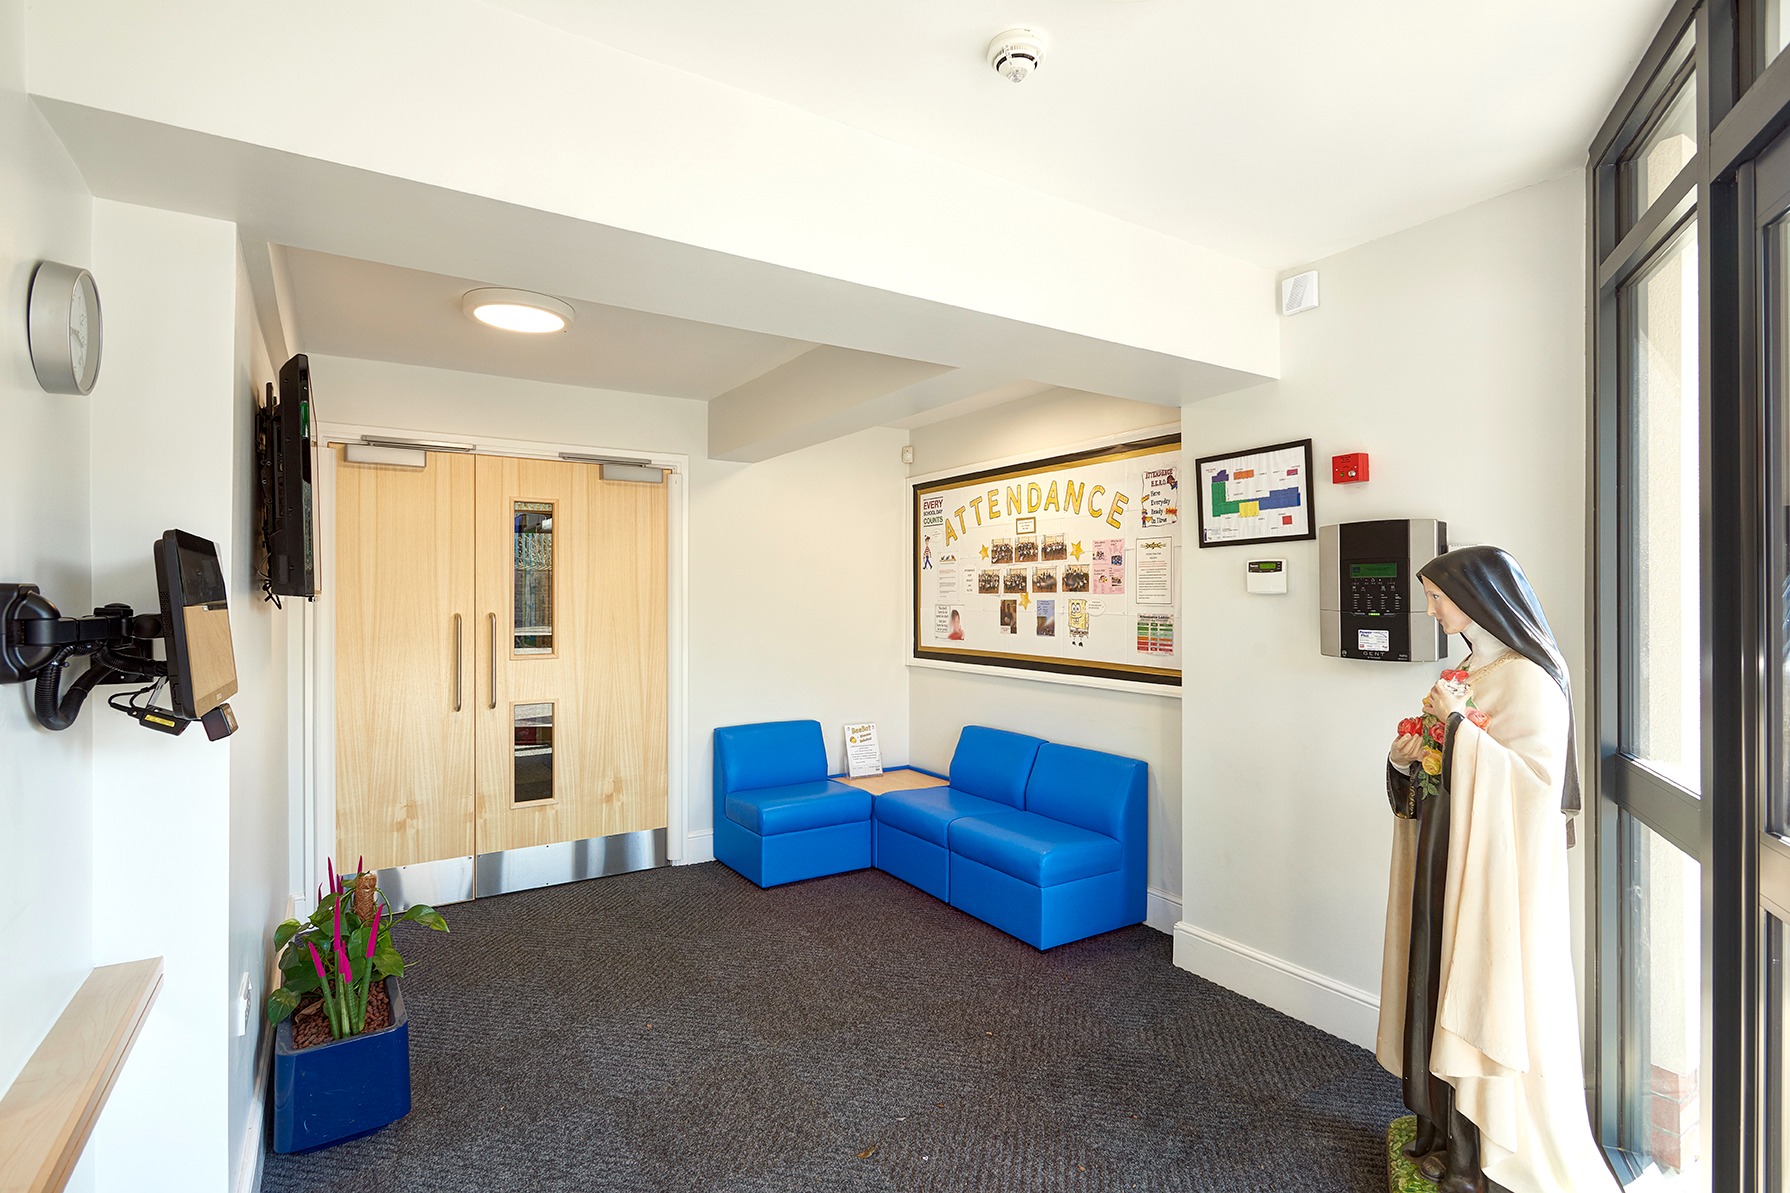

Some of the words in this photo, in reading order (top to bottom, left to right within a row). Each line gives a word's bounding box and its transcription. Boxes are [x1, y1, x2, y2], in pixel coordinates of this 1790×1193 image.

[923, 499, 943, 510] EVERY
[944, 480, 1129, 547] ATTENDANCE
[923, 516, 943, 525] COUNTS
